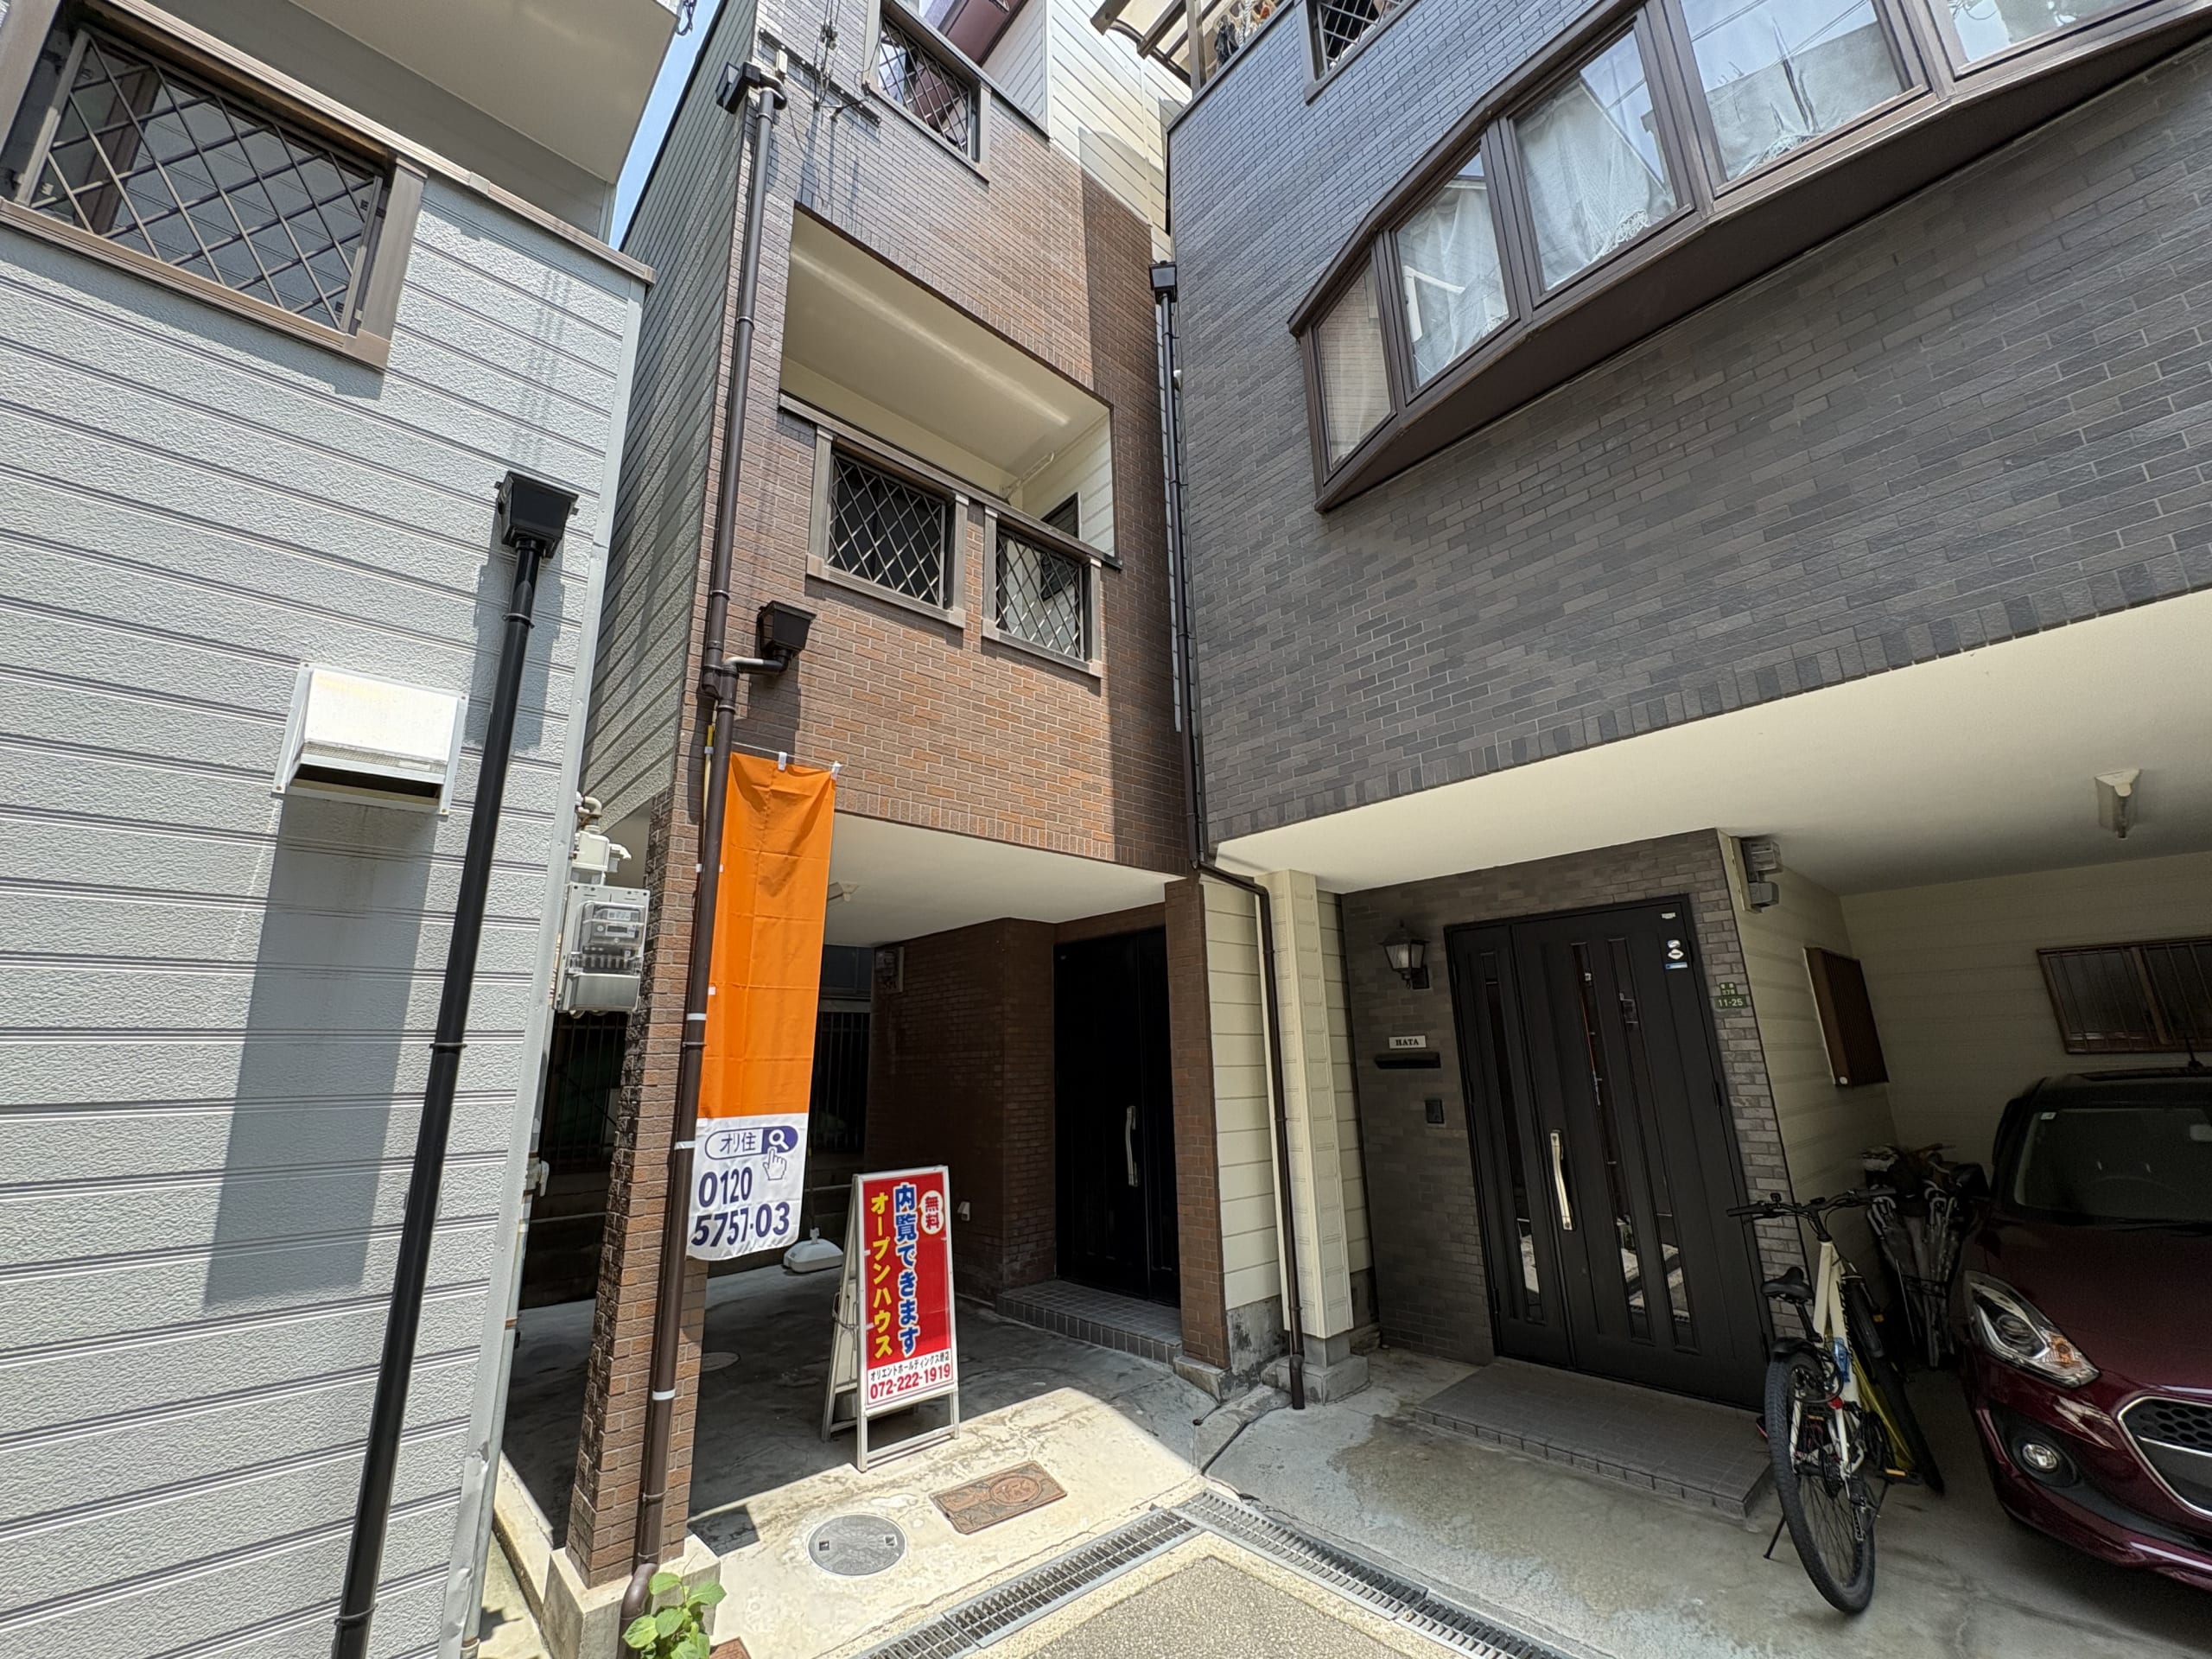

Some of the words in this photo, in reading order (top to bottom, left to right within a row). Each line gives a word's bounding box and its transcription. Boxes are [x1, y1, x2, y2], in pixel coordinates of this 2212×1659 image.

[1719, 998, 1743, 1007] 11-25
[720, 1132, 756, 1154] オリ住
[698, 1166, 753, 1208] 0120
[925, 1196, 939, 1230] 無料
[871, 1192, 893, 1358] オープンハウス
[895, 1185, 918, 1354] 内覧できます
[870, 1363, 950, 1399] 072-222-1919
